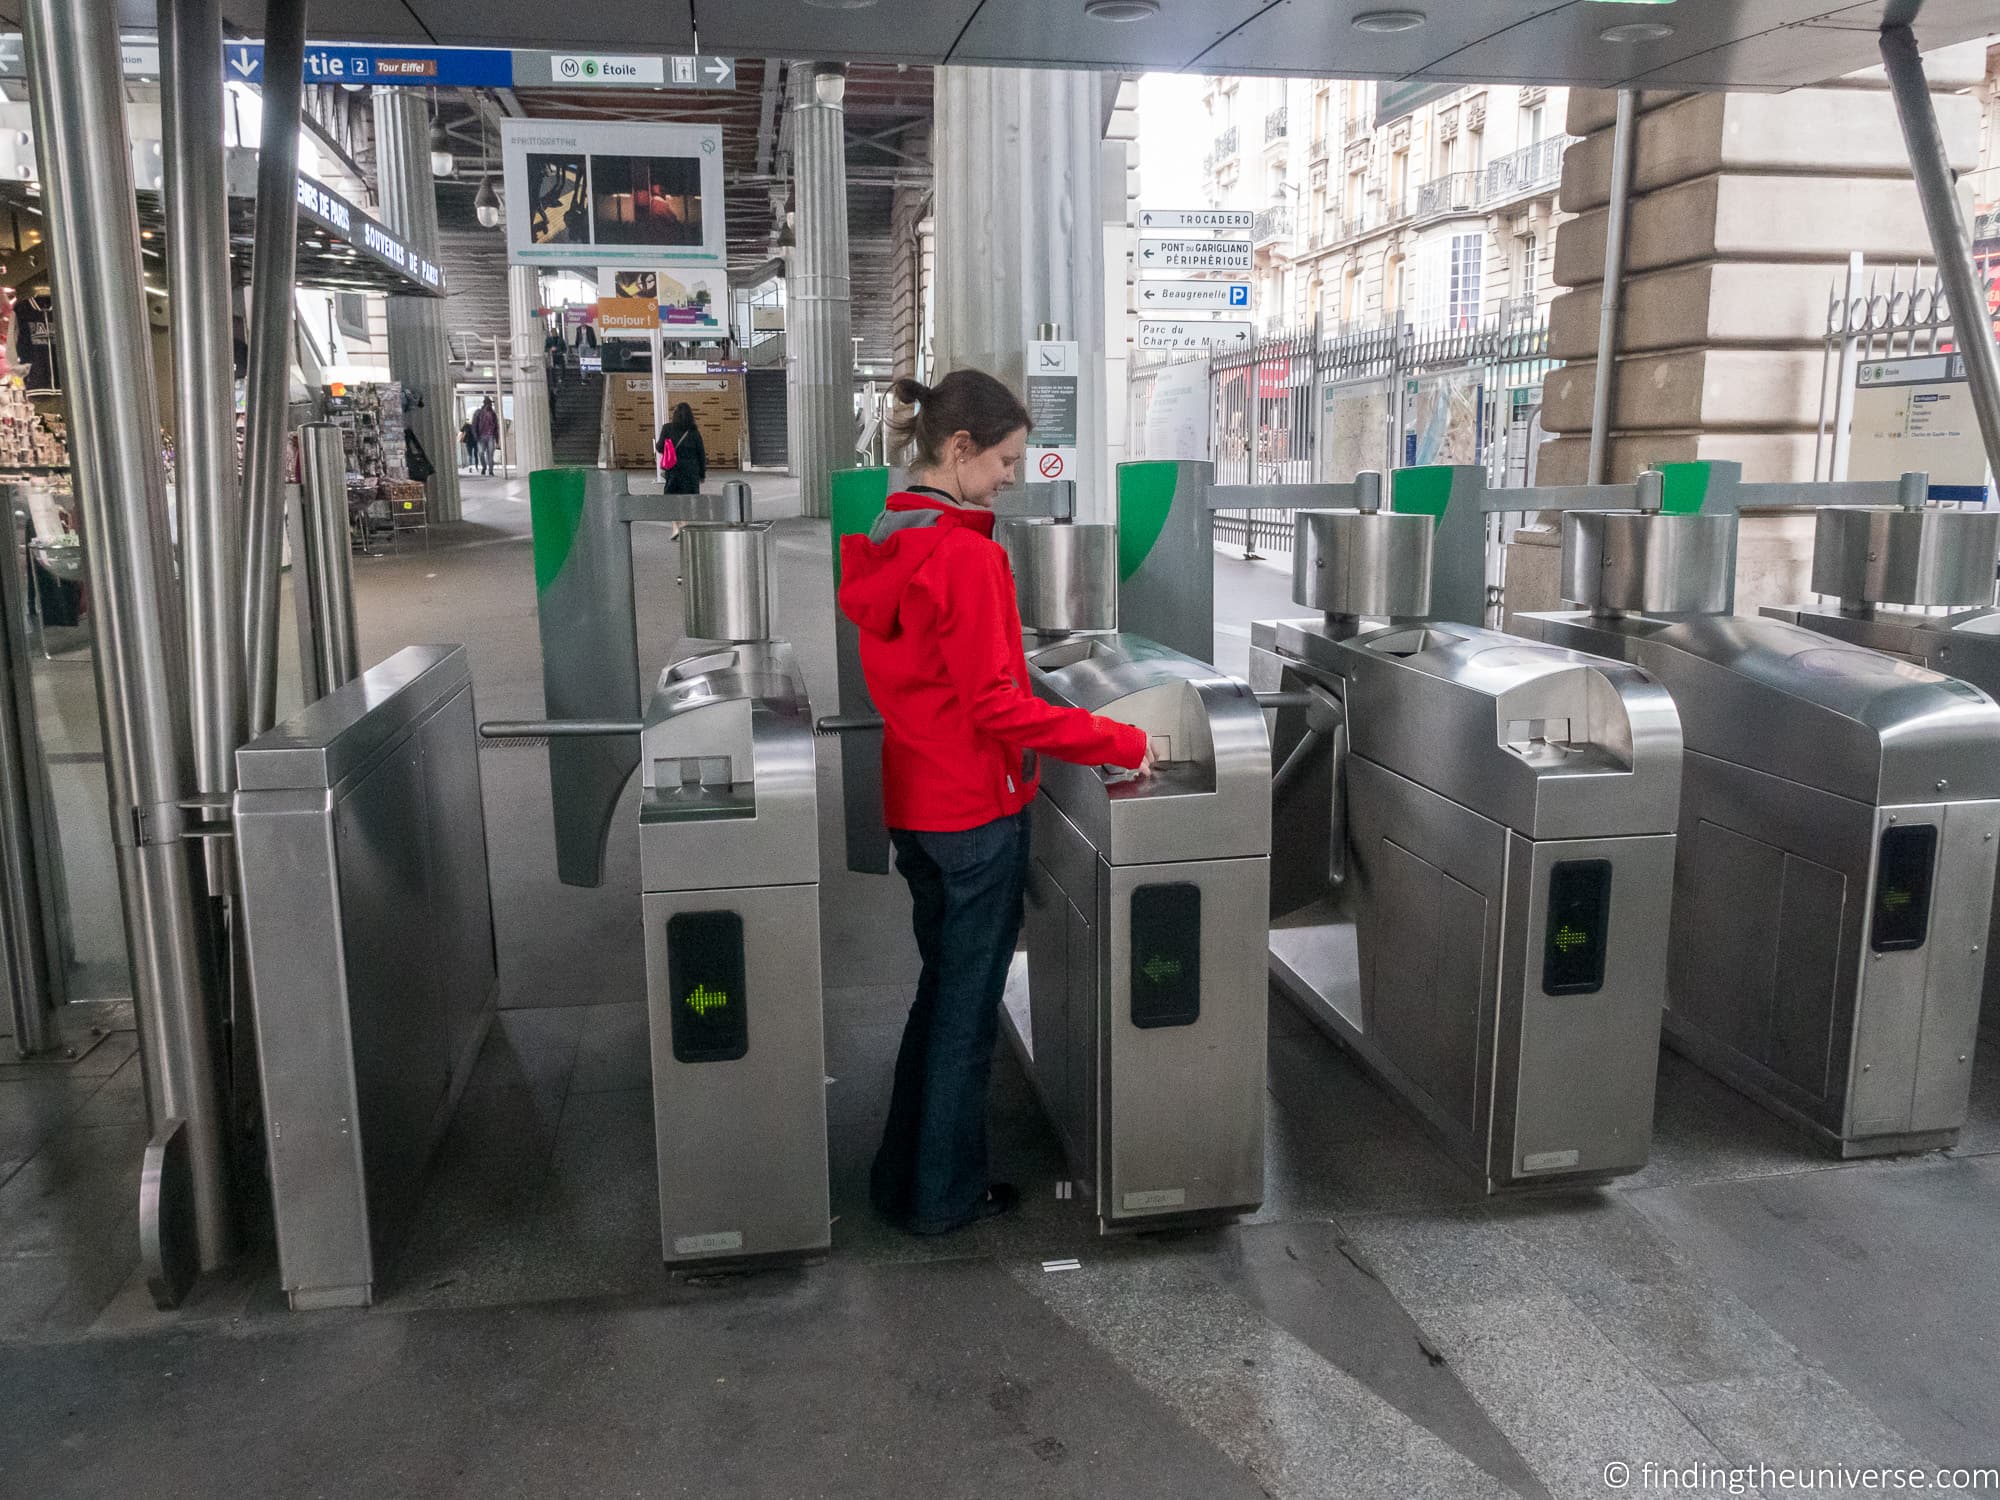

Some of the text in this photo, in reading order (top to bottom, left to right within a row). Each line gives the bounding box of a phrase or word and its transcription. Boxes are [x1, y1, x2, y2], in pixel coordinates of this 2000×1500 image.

[377, 62, 399, 73] Tour
[400, 62, 425, 73] Eiffel
[586, 63, 594, 74] 6
[602, 62, 637, 75] Étoile
[319, 191, 330, 221] DE
[330, 198, 350, 232] PARIS
[1180, 215, 1249, 225] TROCADERO
[1161, 242, 1184, 252] PONT
[1195, 243, 1249, 253] GARIGLIANO
[364, 223, 439, 287] SOUVENIRS DE PARIS
[1162, 288, 1227, 301] Beaugrenelle
[602, 314, 645, 327] Bonjour
[1142, 324, 1184, 335] Parc du
[1184, 336, 1196, 346] de
[1201, 336, 1226, 346] Mrs
